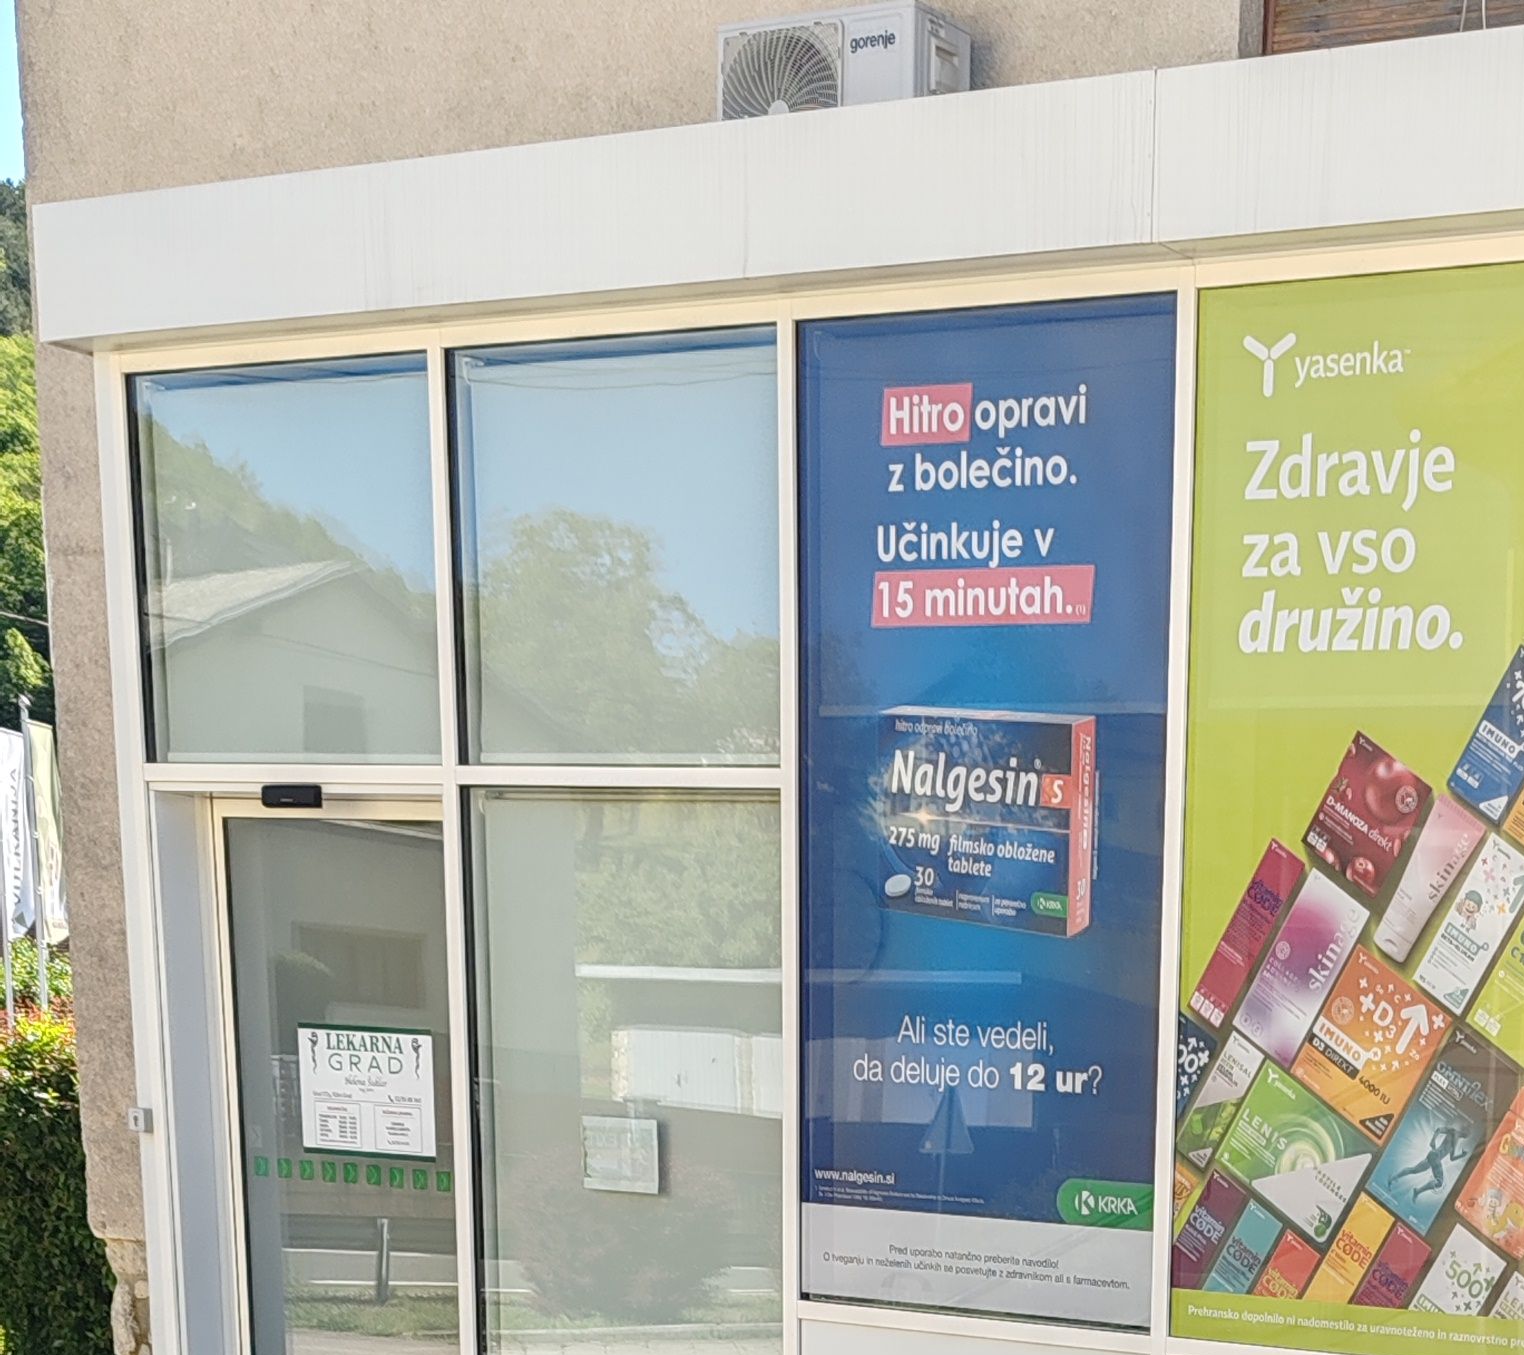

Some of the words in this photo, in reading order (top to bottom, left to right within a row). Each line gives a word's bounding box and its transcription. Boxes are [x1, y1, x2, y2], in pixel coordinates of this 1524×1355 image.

[850, 29, 896, 53] gorenje
[1295, 340, 1405, 389] yasenka
[889, 395, 964, 434] Hitro
[975, 384, 1087, 438] opravi
[888, 463, 904, 492] z
[915, 446, 1077, 491] bolečino.
[1244, 429, 1455, 512] Zdravje
[877, 520, 1023, 568] Učinkuje
[1034, 529, 1055, 557] v
[1242, 532, 1300, 578] za
[1317, 527, 1416, 575] vso
[878, 581, 913, 617] 15
[925, 576, 1073, 616] minutah.
[1238, 586, 1463, 655] družino.
[1482, 724, 1515, 753] IMUNO
[891, 749, 1038, 812] Nalgesin
[1327, 795, 1368, 833] D-MANOZA
[889, 826, 915, 848] 275
[918, 832, 940, 855] mg
[947, 834, 994, 856] filmsko
[997, 840, 1055, 864] obložene
[914, 866, 934, 886] 30
[948, 857, 992, 877] tablete
[326, 1032, 403, 1054] LEKARNA
[897, 1015, 925, 1044] Ali
[933, 1020, 970, 1047] ste
[977, 1022, 1054, 1056] vedeli,
[1319, 1023, 1361, 1061] IMUNO
[328, 1052, 403, 1074] GRAD
[853, 1053, 883, 1083] da
[890, 1055, 960, 1093] deluje
[968, 1060, 1000, 1089] do
[1009, 1061, 1046, 1092] 12
[1056, 1066, 1103, 1096] ur?
[1243, 1108, 1287, 1150] LENIS
[814, 1168, 895, 1185] www.nalgesin.si
[1098, 1195, 1138, 1216] KRKA
[889, 1244, 907, 1256] Pred
[910, 1247, 943, 1259] uporabo
[984, 1253, 1020, 1266] preberite
[1341, 1229, 1372, 1259] vitamin
[823, 1252, 830, 1262] O
[1006, 1270, 1053, 1282] zdravnikom
[1055, 1274, 1064, 1283] ali
[1188, 1305, 1239, 1320] Prehransko
[1242, 1310, 1284, 1324] dopolnilo
[1286, 1315, 1295, 1324] ni
[1298, 1317, 1354, 1331] nadomestilo
[1357, 1323, 1367, 1332] za
[1370, 1323, 1435, 1339] uravnoteženo
[1438, 1329, 1447, 1339] in
[1449, 1332, 1507, 1346] raznovrstno
